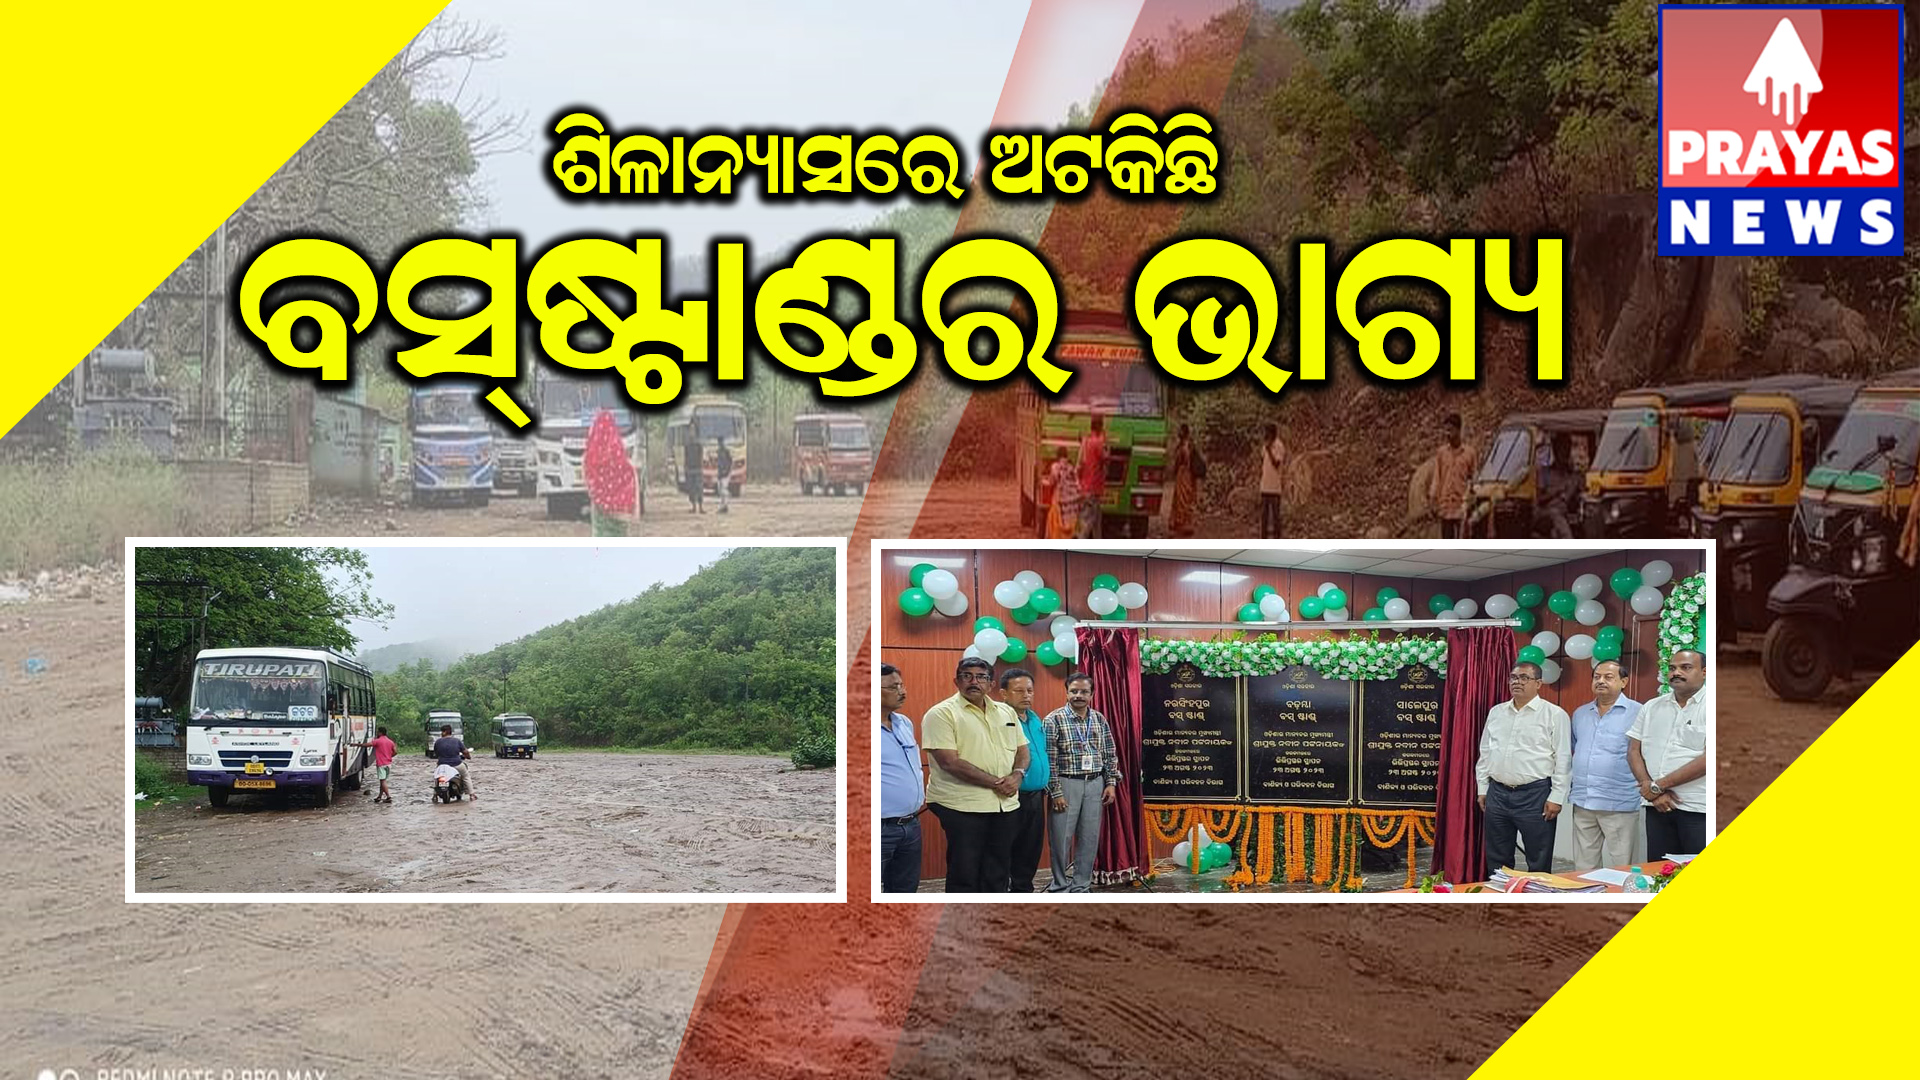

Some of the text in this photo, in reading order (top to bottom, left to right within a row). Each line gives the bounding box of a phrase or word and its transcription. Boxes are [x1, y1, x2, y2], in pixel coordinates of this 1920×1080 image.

[204, 663, 318, 676] TIRUPATI
[1396, 701, 1438, 711] ସାଲେପୁର
[1168, 711, 1184, 721] ବସ୍
[1279, 713, 1295, 722] ବସ୍
[1396, 714, 1413, 723] ବସ୍
